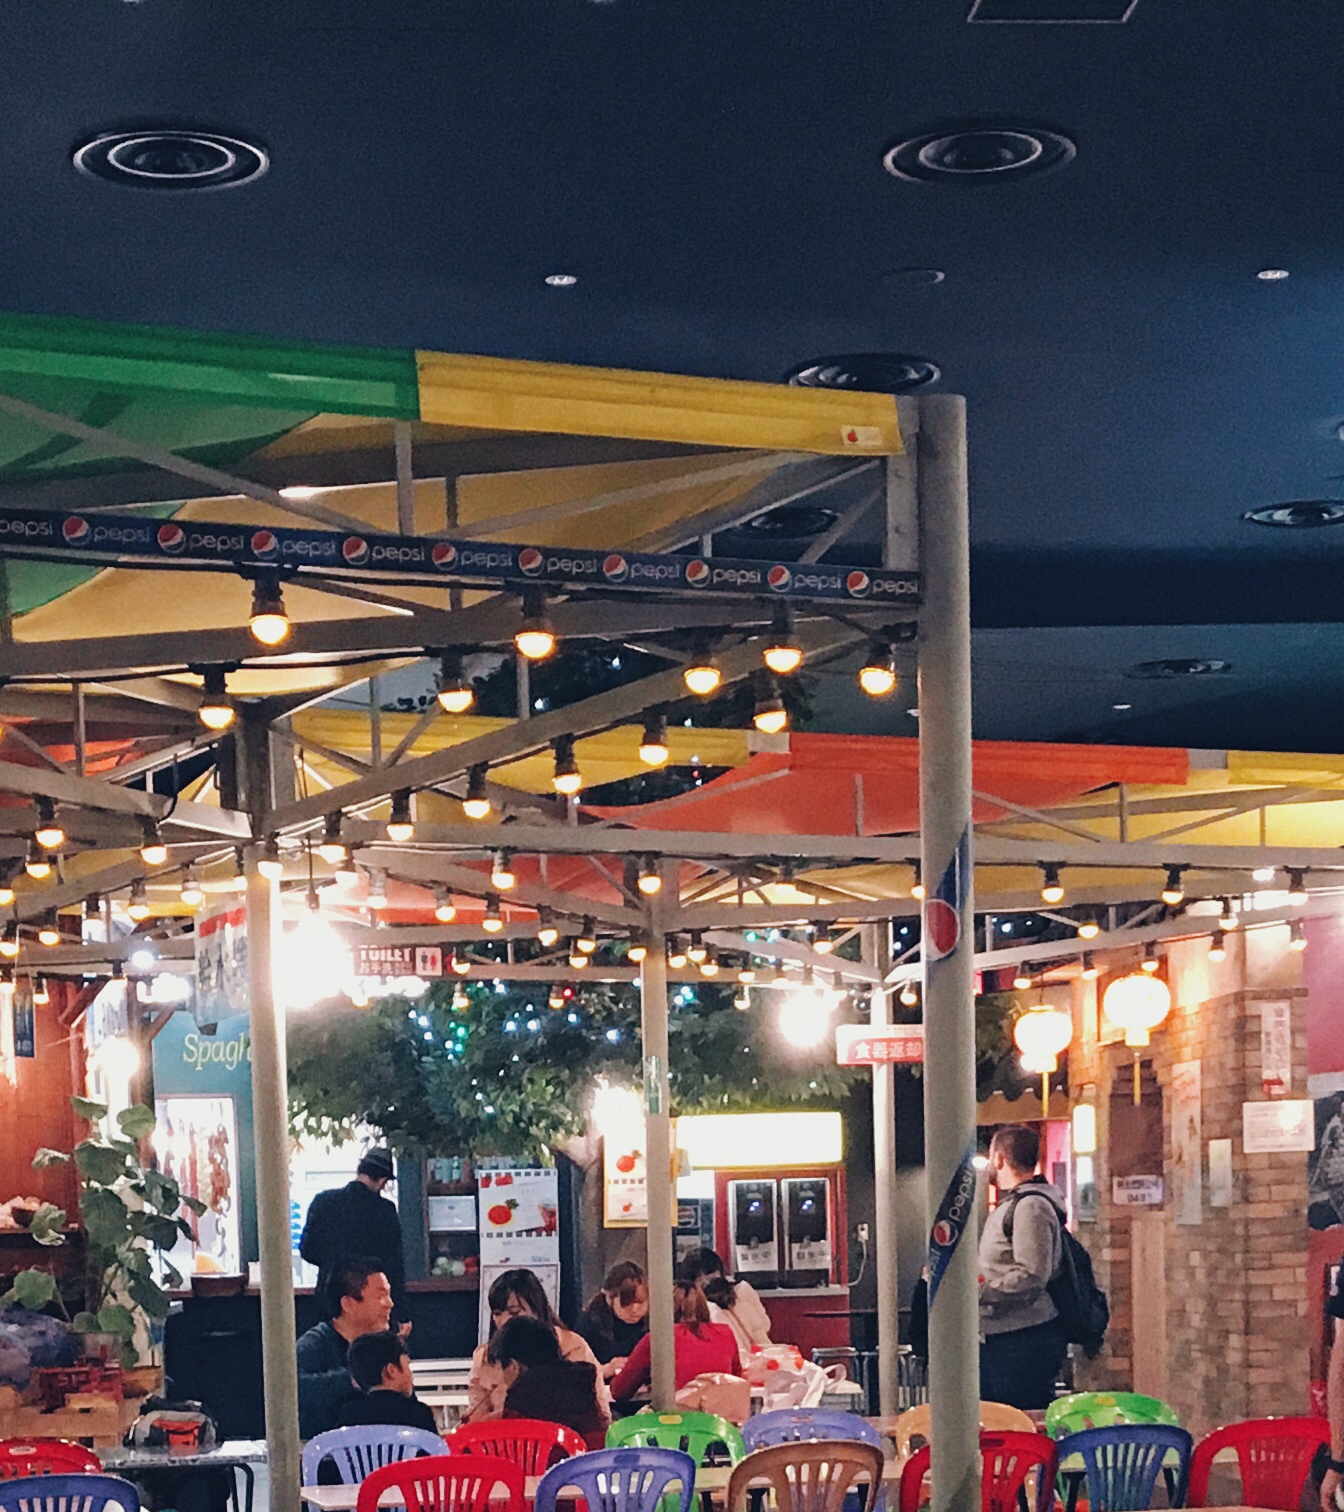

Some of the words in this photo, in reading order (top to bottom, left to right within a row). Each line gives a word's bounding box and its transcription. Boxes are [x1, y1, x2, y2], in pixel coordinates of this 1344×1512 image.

[93, 525, 150, 544] pepsi
[188, 532, 244, 551] pepsi
[281, 539, 336, 557] pepsi
[371, 544, 425, 562] pepsi
[460, 549, 513, 568] pepsi
[547, 557, 597, 575] pepsi
[630, 562, 680, 580] pepsi
[713, 568, 761, 586] pepsi
[795, 573, 842, 591] pepsi
[872, 578, 918, 595] pepsi
[358, 945, 412, 962] TOILET
[948, 1168, 974, 1222] pepsi
